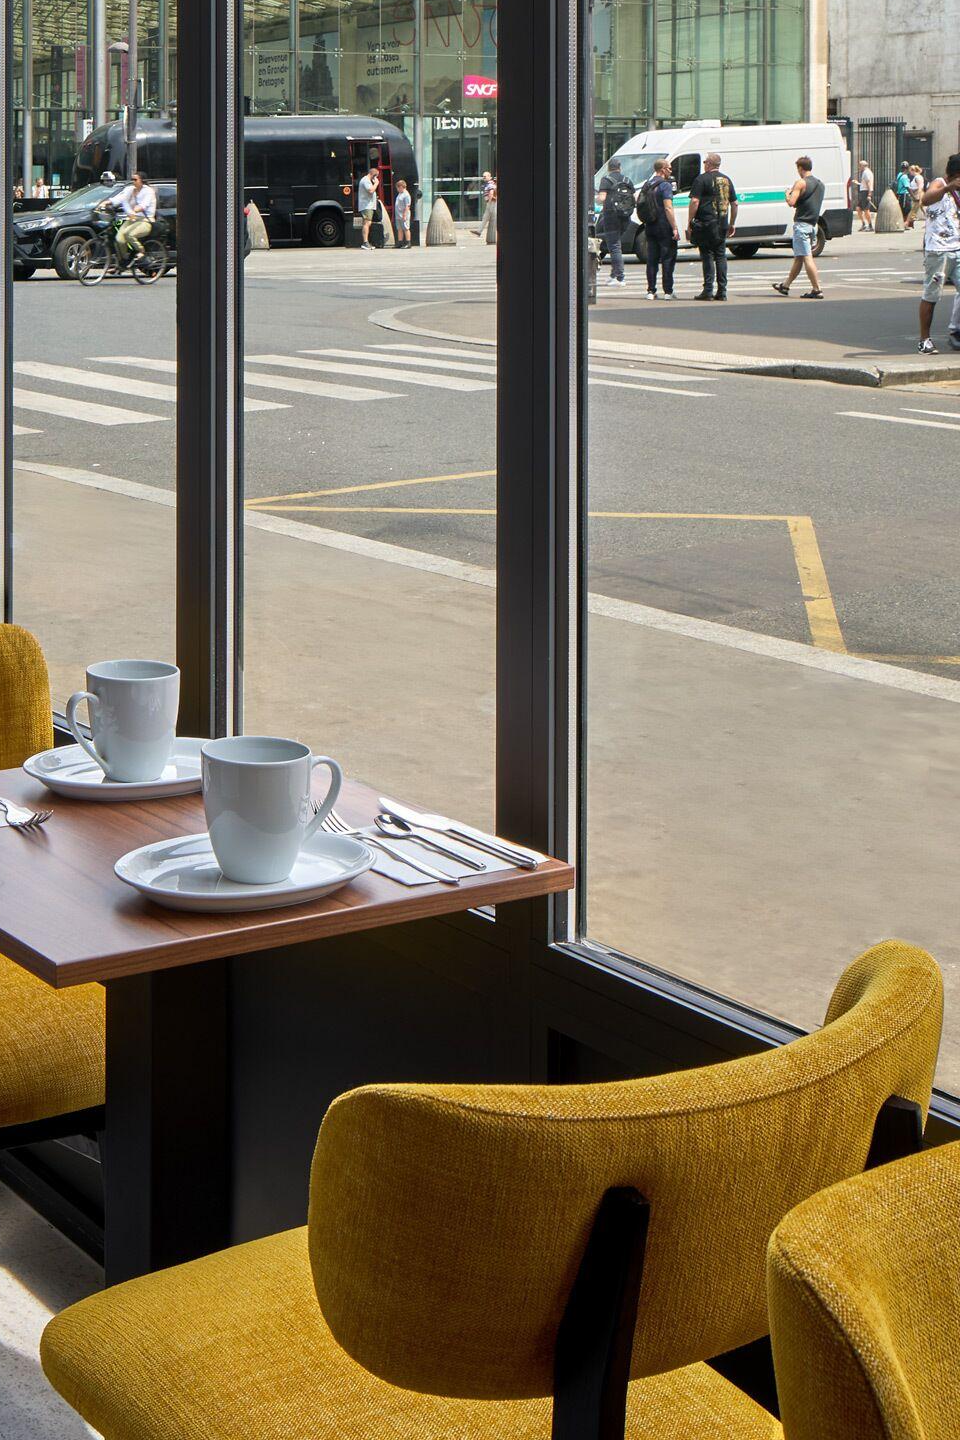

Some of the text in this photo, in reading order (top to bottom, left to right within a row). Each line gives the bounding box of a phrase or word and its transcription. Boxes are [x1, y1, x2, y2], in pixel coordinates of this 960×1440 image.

[258, 54, 288, 64] Bienvenue
[258, 77, 285, 88] Bretagne
[465, 83, 497, 96] SNCF
